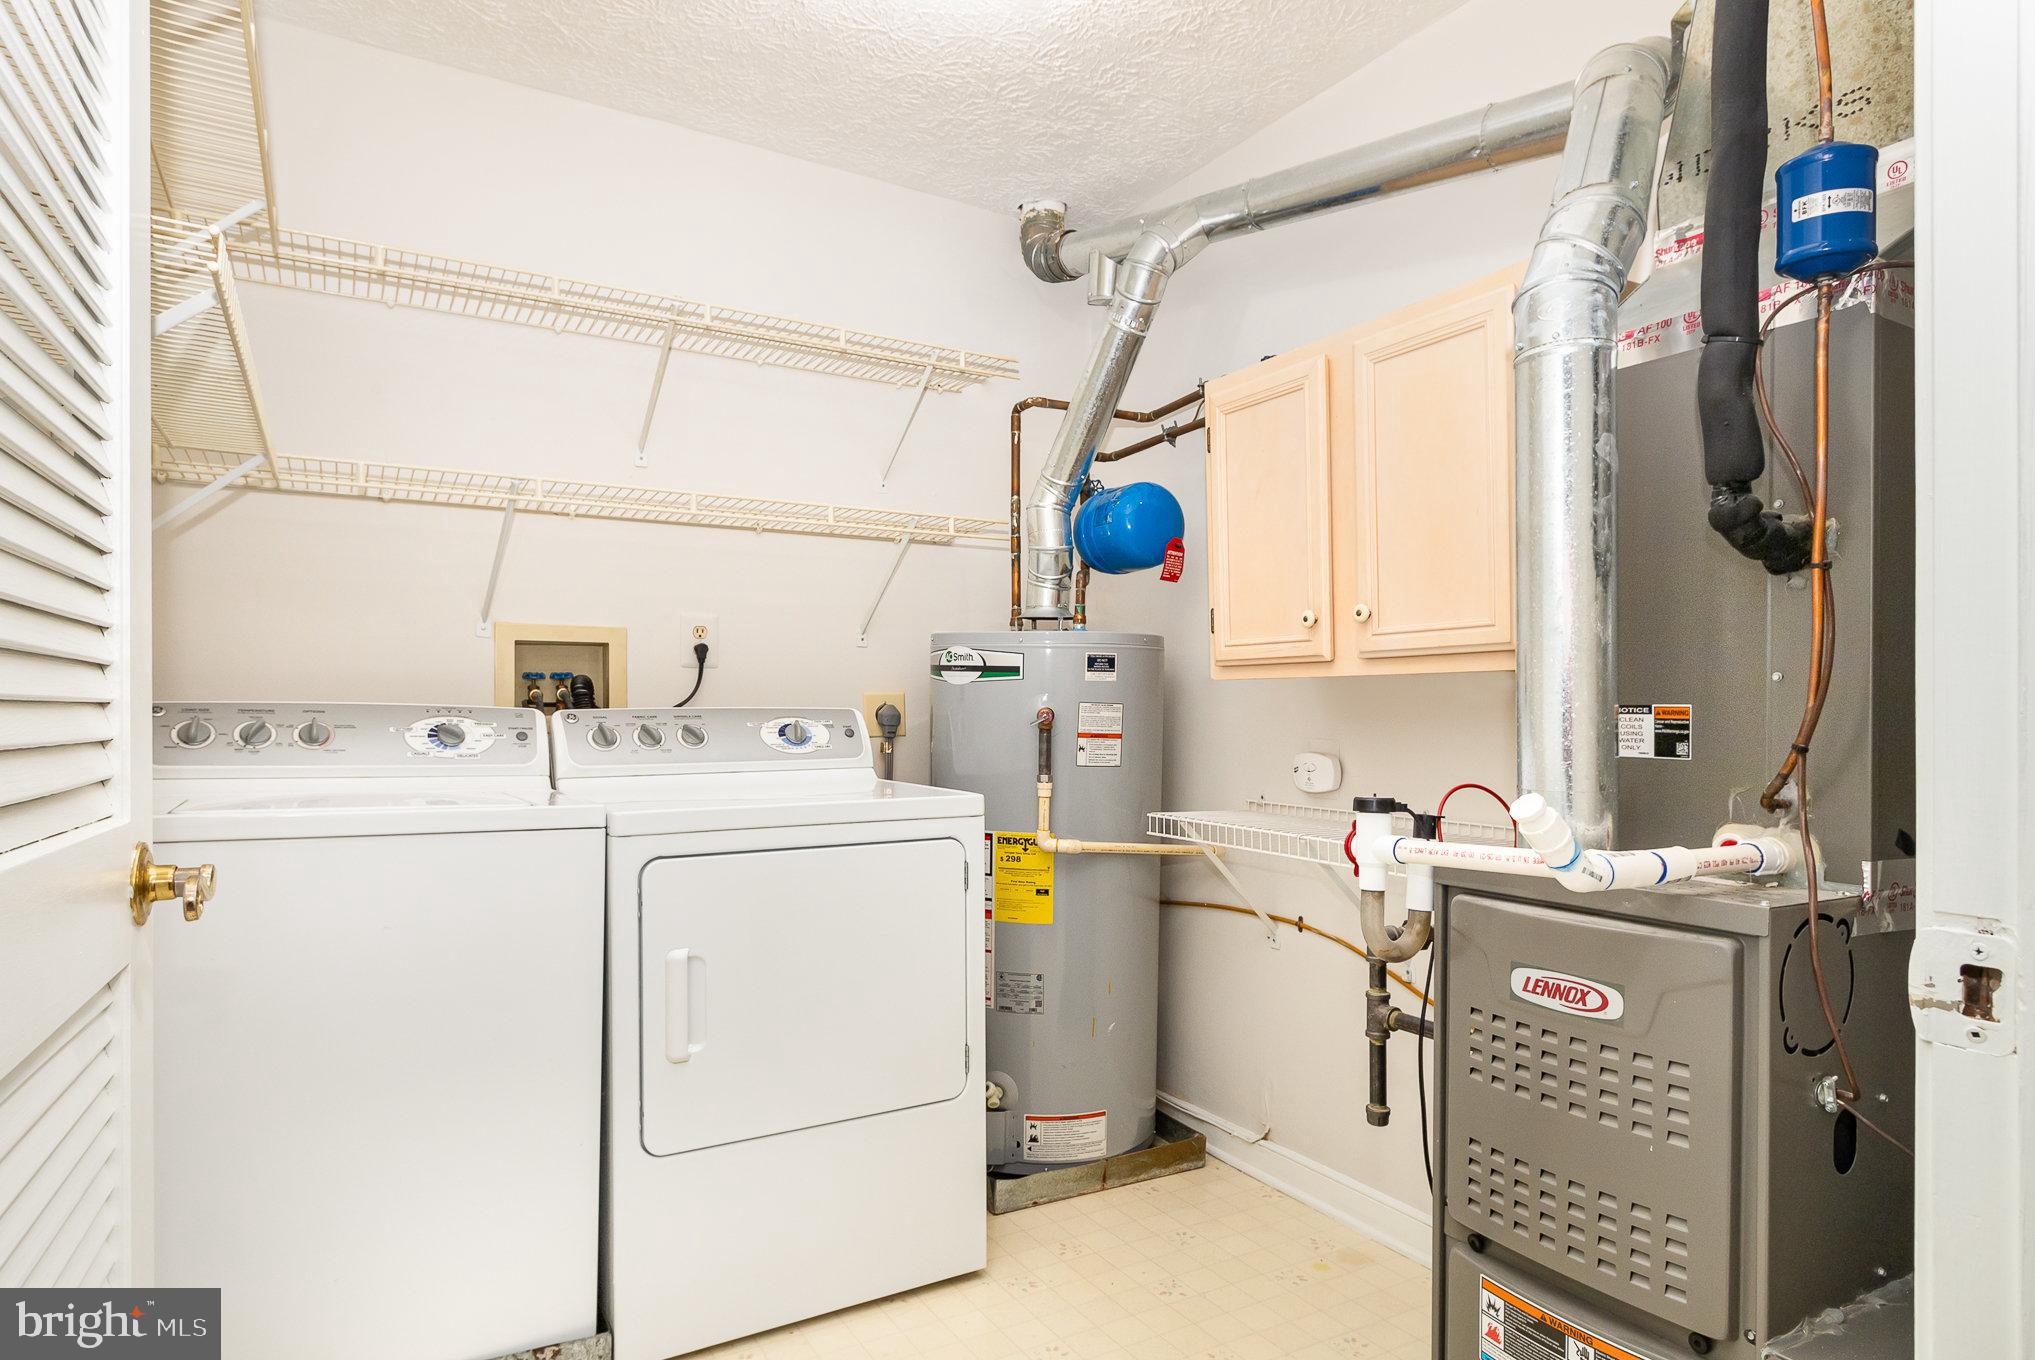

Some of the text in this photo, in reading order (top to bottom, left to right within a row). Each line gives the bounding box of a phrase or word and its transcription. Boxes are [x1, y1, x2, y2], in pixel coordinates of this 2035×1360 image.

[1775, 283, 1790, 295] AF
[1637, 318, 1673, 336] AF 100
[1005, 855, 1022, 863] 298
[1522, 976, 1591, 1007] LENNOX
[1548, 1317, 1594, 1347] WARNING
